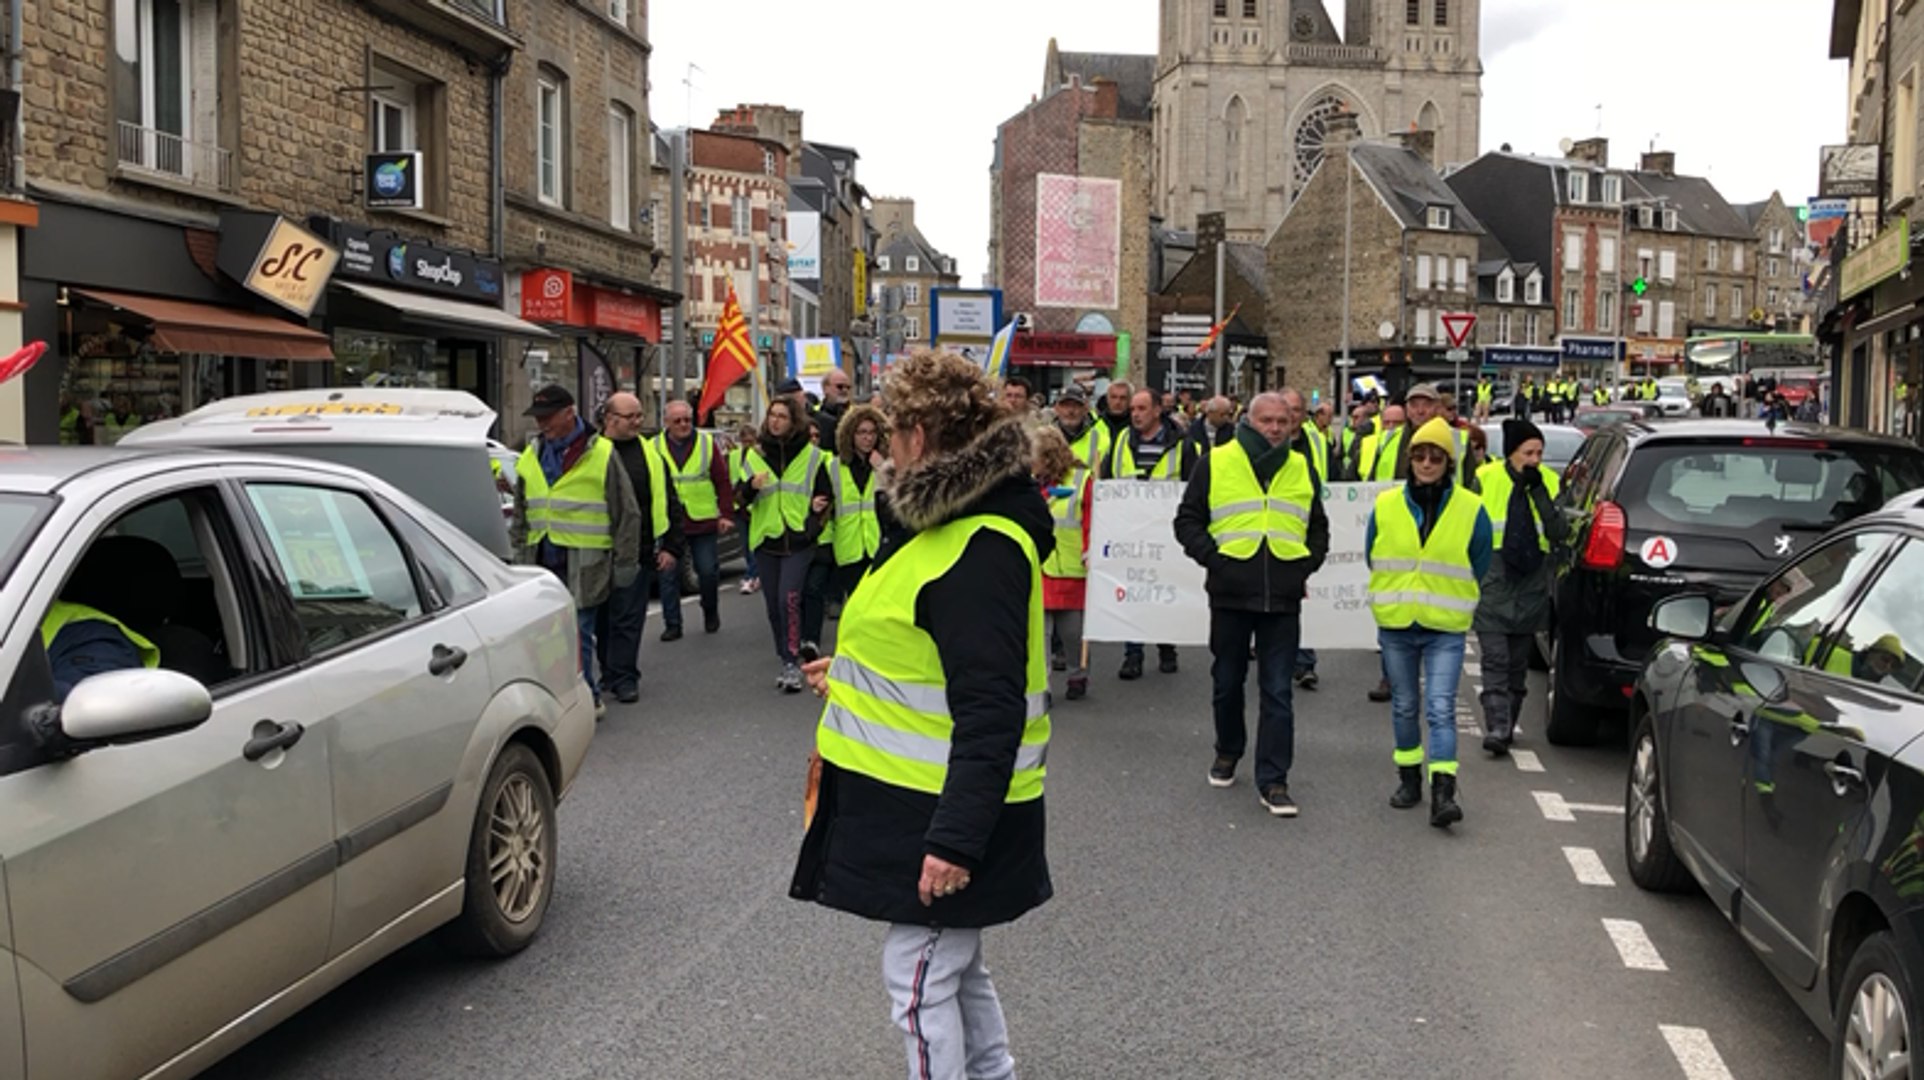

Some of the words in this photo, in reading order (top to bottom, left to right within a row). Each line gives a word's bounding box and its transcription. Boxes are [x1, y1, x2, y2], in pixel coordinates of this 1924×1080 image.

[525, 299, 564, 308] SAINT
[1095, 483, 1180, 501] CONSTRUI
[1647, 537, 1669, 562] A
[1126, 567, 1158, 583] DES
